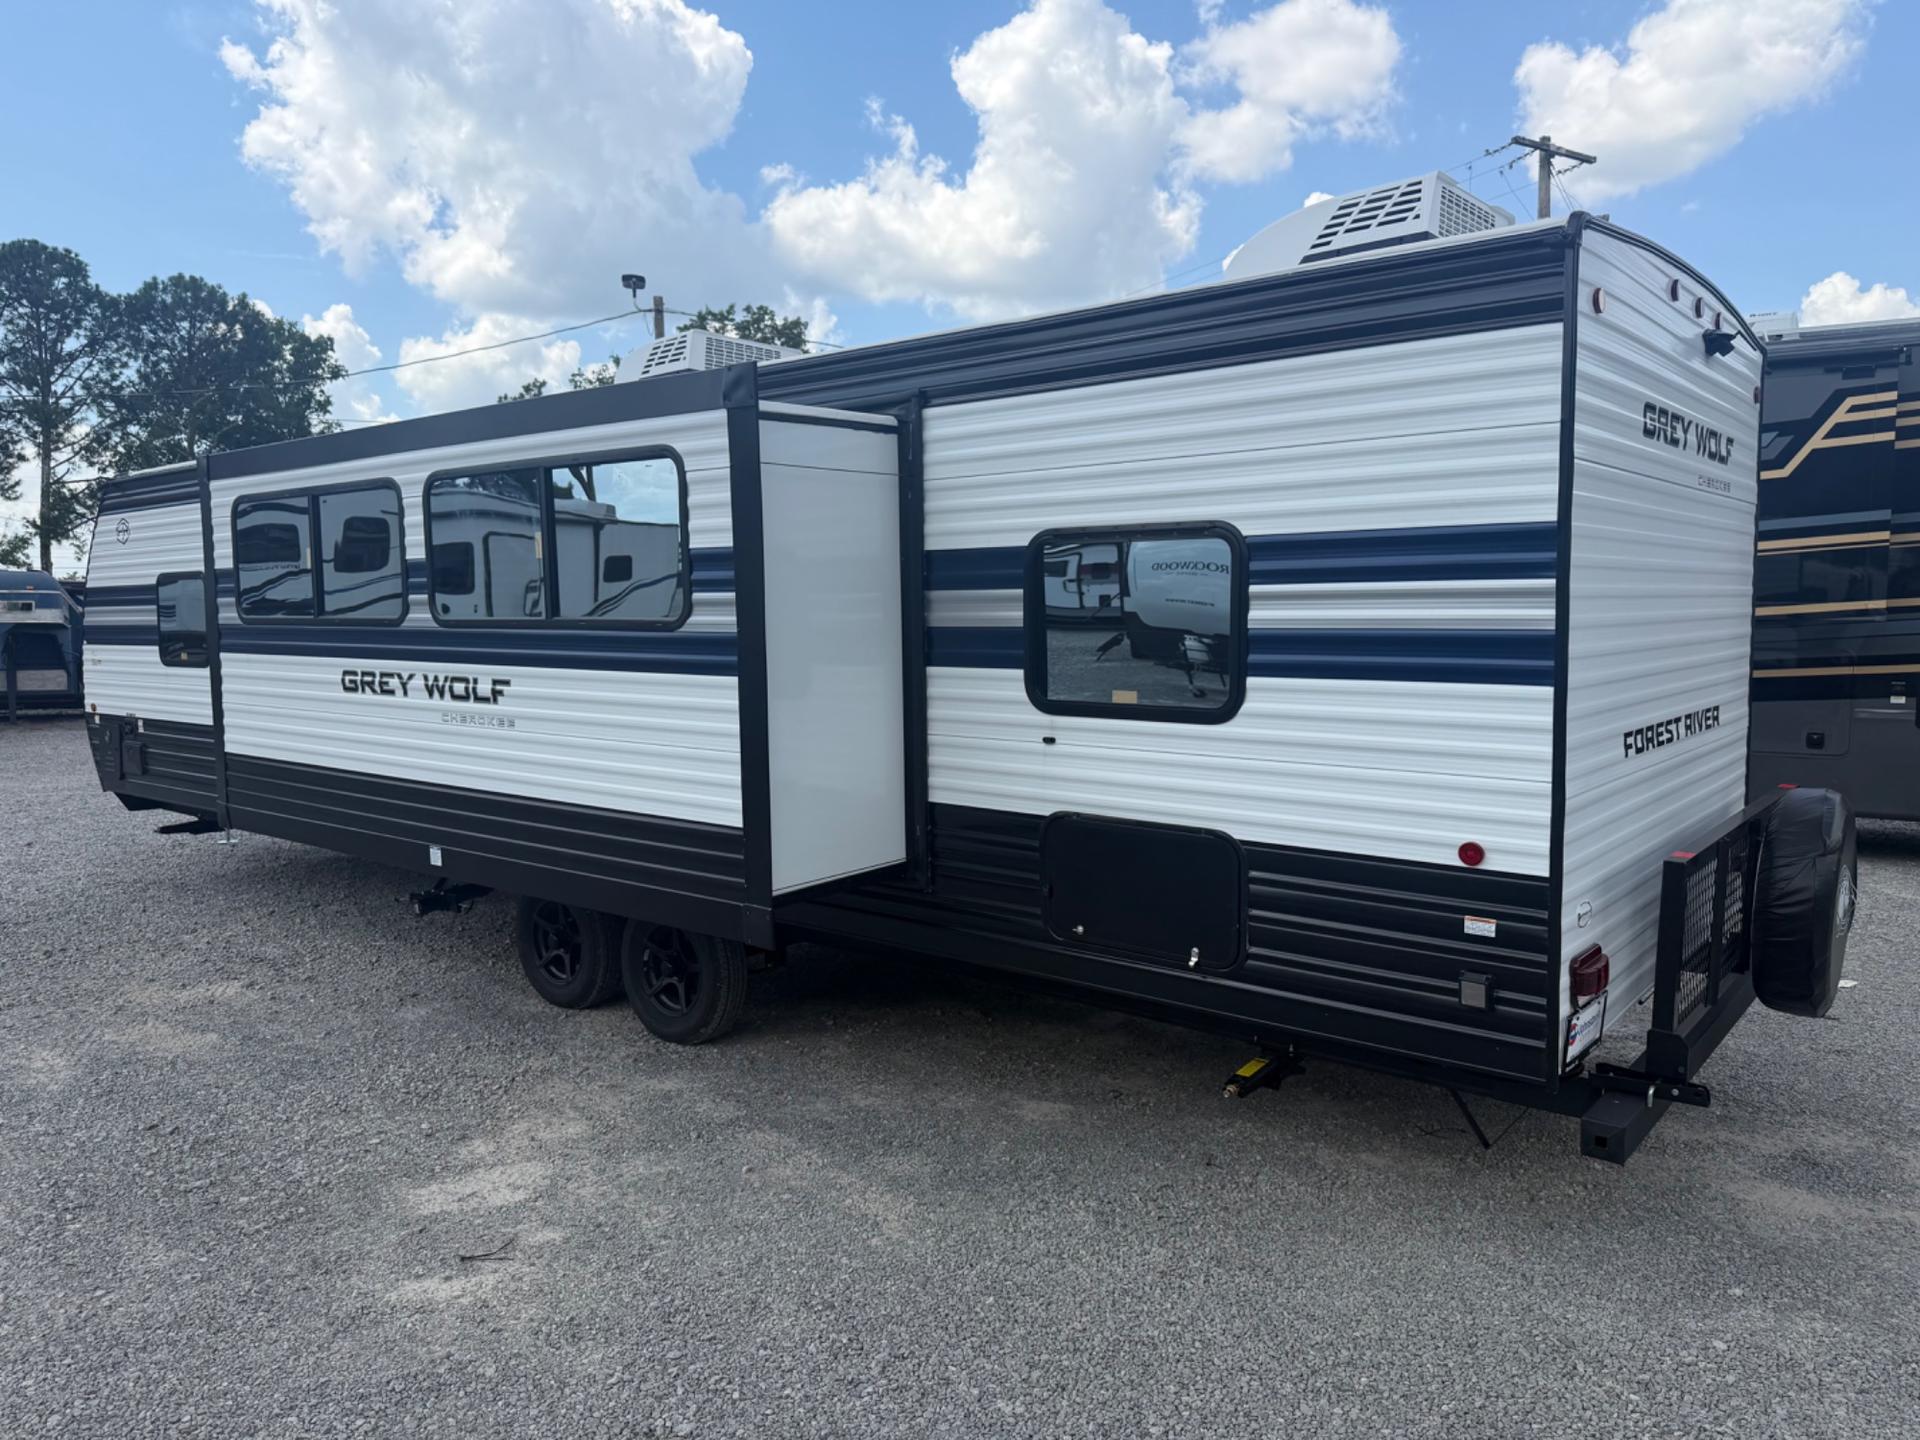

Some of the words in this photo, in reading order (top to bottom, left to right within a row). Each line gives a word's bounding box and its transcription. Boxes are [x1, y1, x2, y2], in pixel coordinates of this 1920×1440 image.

[1642, 401, 1693, 451] GREY
[1695, 422, 1735, 466] WOLF
[341, 669, 416, 698] GREY
[422, 673, 512, 705] WOLF
[1623, 715, 1682, 759] FOREST
[1684, 705, 1720, 737] RIVER
